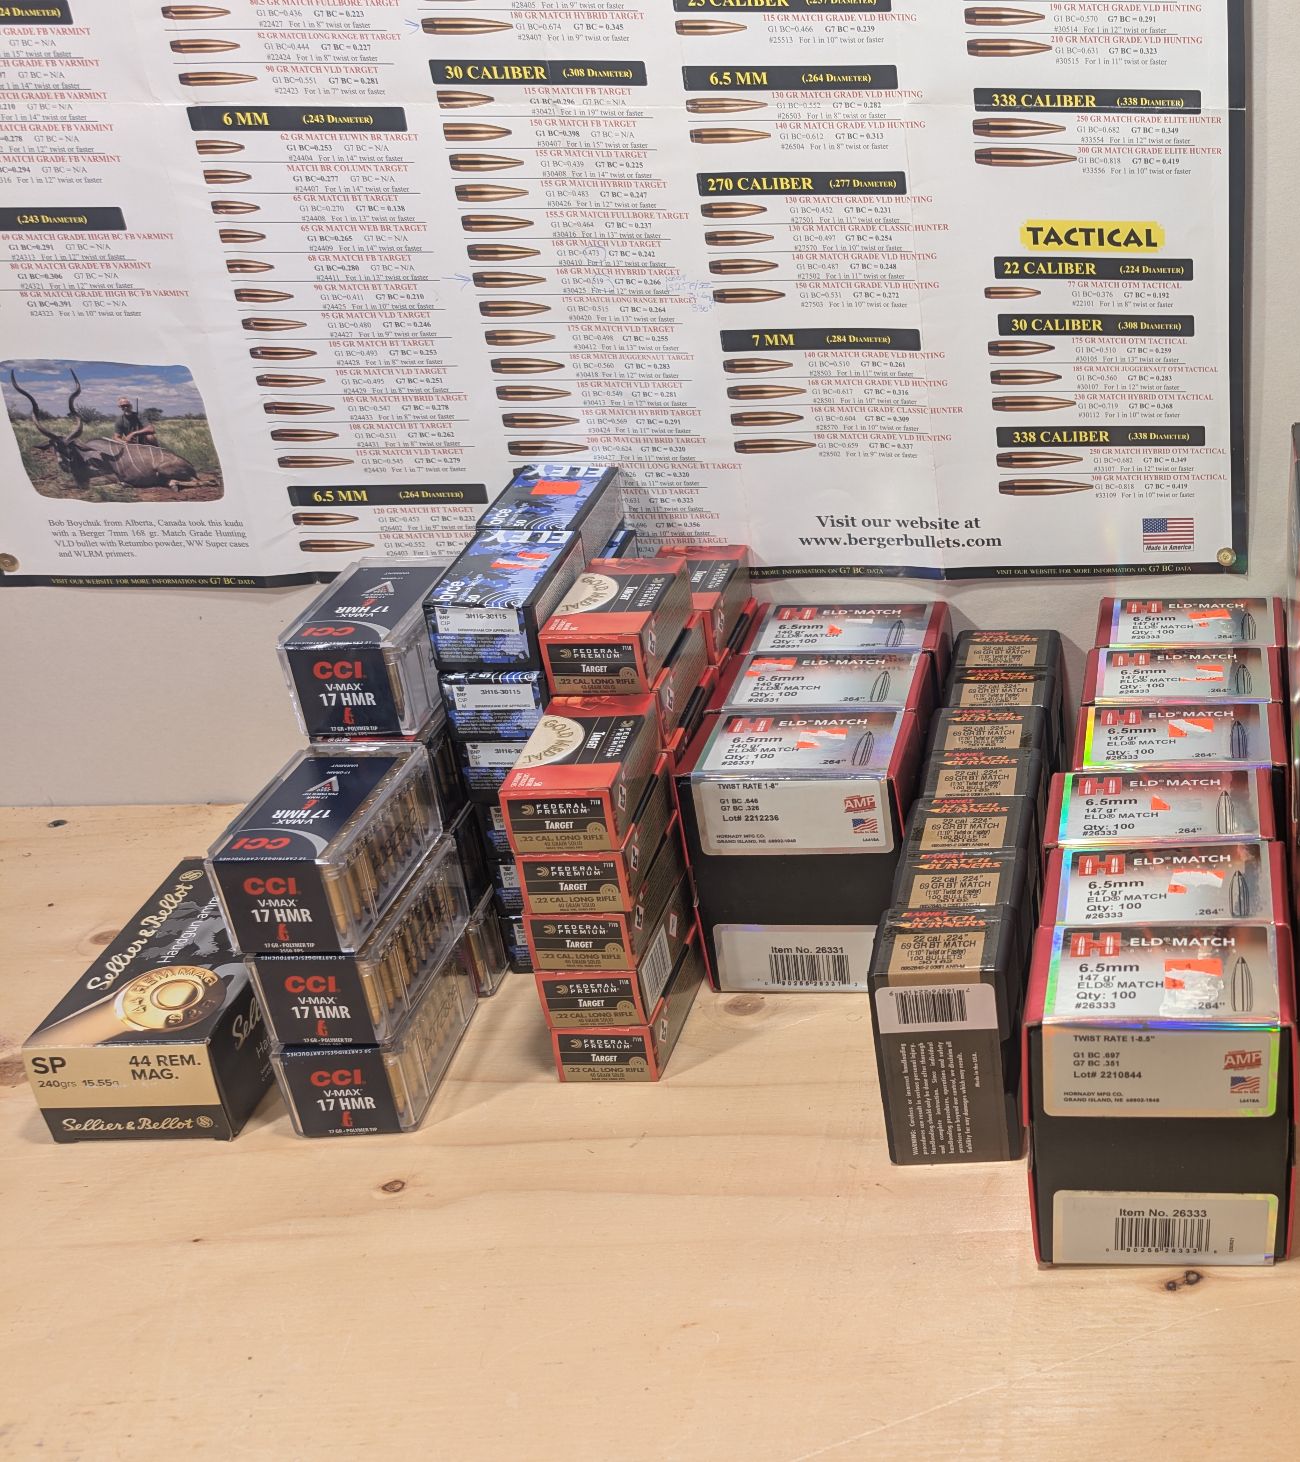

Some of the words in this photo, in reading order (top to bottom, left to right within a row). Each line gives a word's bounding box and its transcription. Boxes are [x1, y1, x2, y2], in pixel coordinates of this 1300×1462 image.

[446, 66, 462, 79] 30
[468, 66, 547, 80] CALIBER
[563, 69, 585, 78] (.308
[710, 72, 731, 85] 6.5
[736, 72, 768, 85] MM
[802, 74, 823, 83] (.264
[992, 94, 1017, 107] 338
[1021, 95, 1096, 107] CALIBER
[1117, 97, 1137, 106] (.338
[223, 112, 232, 126] 6
[236, 113, 269, 126] MM
[303, 115, 324, 124] (.243
[708, 178, 733, 191] 270
[738, 177, 813, 190] CALIBER
[829, 179, 850, 188] (.277
[1027, 227, 1157, 247] TACTICAL
[1004, 262, 1019, 274] 22
[1024, 262, 1096, 275] CALIBER
[1120, 265, 1139, 274] (.224
[1011, 319, 1027, 331] 30
[1031, 319, 1103, 331] CALIBER
[752, 335, 760, 346] 7
[766, 334, 795, 346] MM
[827, 335, 846, 344] (.284
[1013, 432, 1036, 442] 338
[1040, 431, 1110, 442] CALIBER
[313, 491, 334, 502] 6.5
[338, 490, 368, 501] MM
[68, 520, 100, 528] Boychuk
[816, 515, 857, 527] Visit
[862, 517, 891, 528] our
[896, 517, 960, 529] website
[965, 518, 981, 529] at
[80, 530, 105, 539] Berger
[216, 530, 246, 539] Hunting
[799, 534, 1002, 548] www.bergerbullets.com
[313, 660, 363, 679] CCI
[319, 693, 336, 706] 17
[341, 693, 376, 706] HMR
[243, 877, 297, 895] CCI
[258, 899, 296, 907] V-MAX
[251, 909, 270, 922] 17
[276, 909, 312, 922] HMR
[901, 941, 913, 949] 69
[913, 935, 924, 943] 22
[927, 934, 940, 942] cal
[1079, 963, 1139, 973] 6.5mm
[1077, 991, 1106, 1001] Qty:
[1112, 991, 1136, 999] 100
[32, 1056, 66, 1074] SP
[129, 1055, 151, 1067] 44
[157, 1054, 201, 1067] REM.
[38, 1080, 76, 1089] 240grs
[131, 1069, 178, 1080] MAG.
[62, 1119, 124, 1132] Sellier
[138, 1118, 193, 1130] Bellot
[1119, 1209, 1145, 1217] Item
[1149, 1209, 1168, 1217] No.
[1173, 1209, 1207, 1217] 26333
